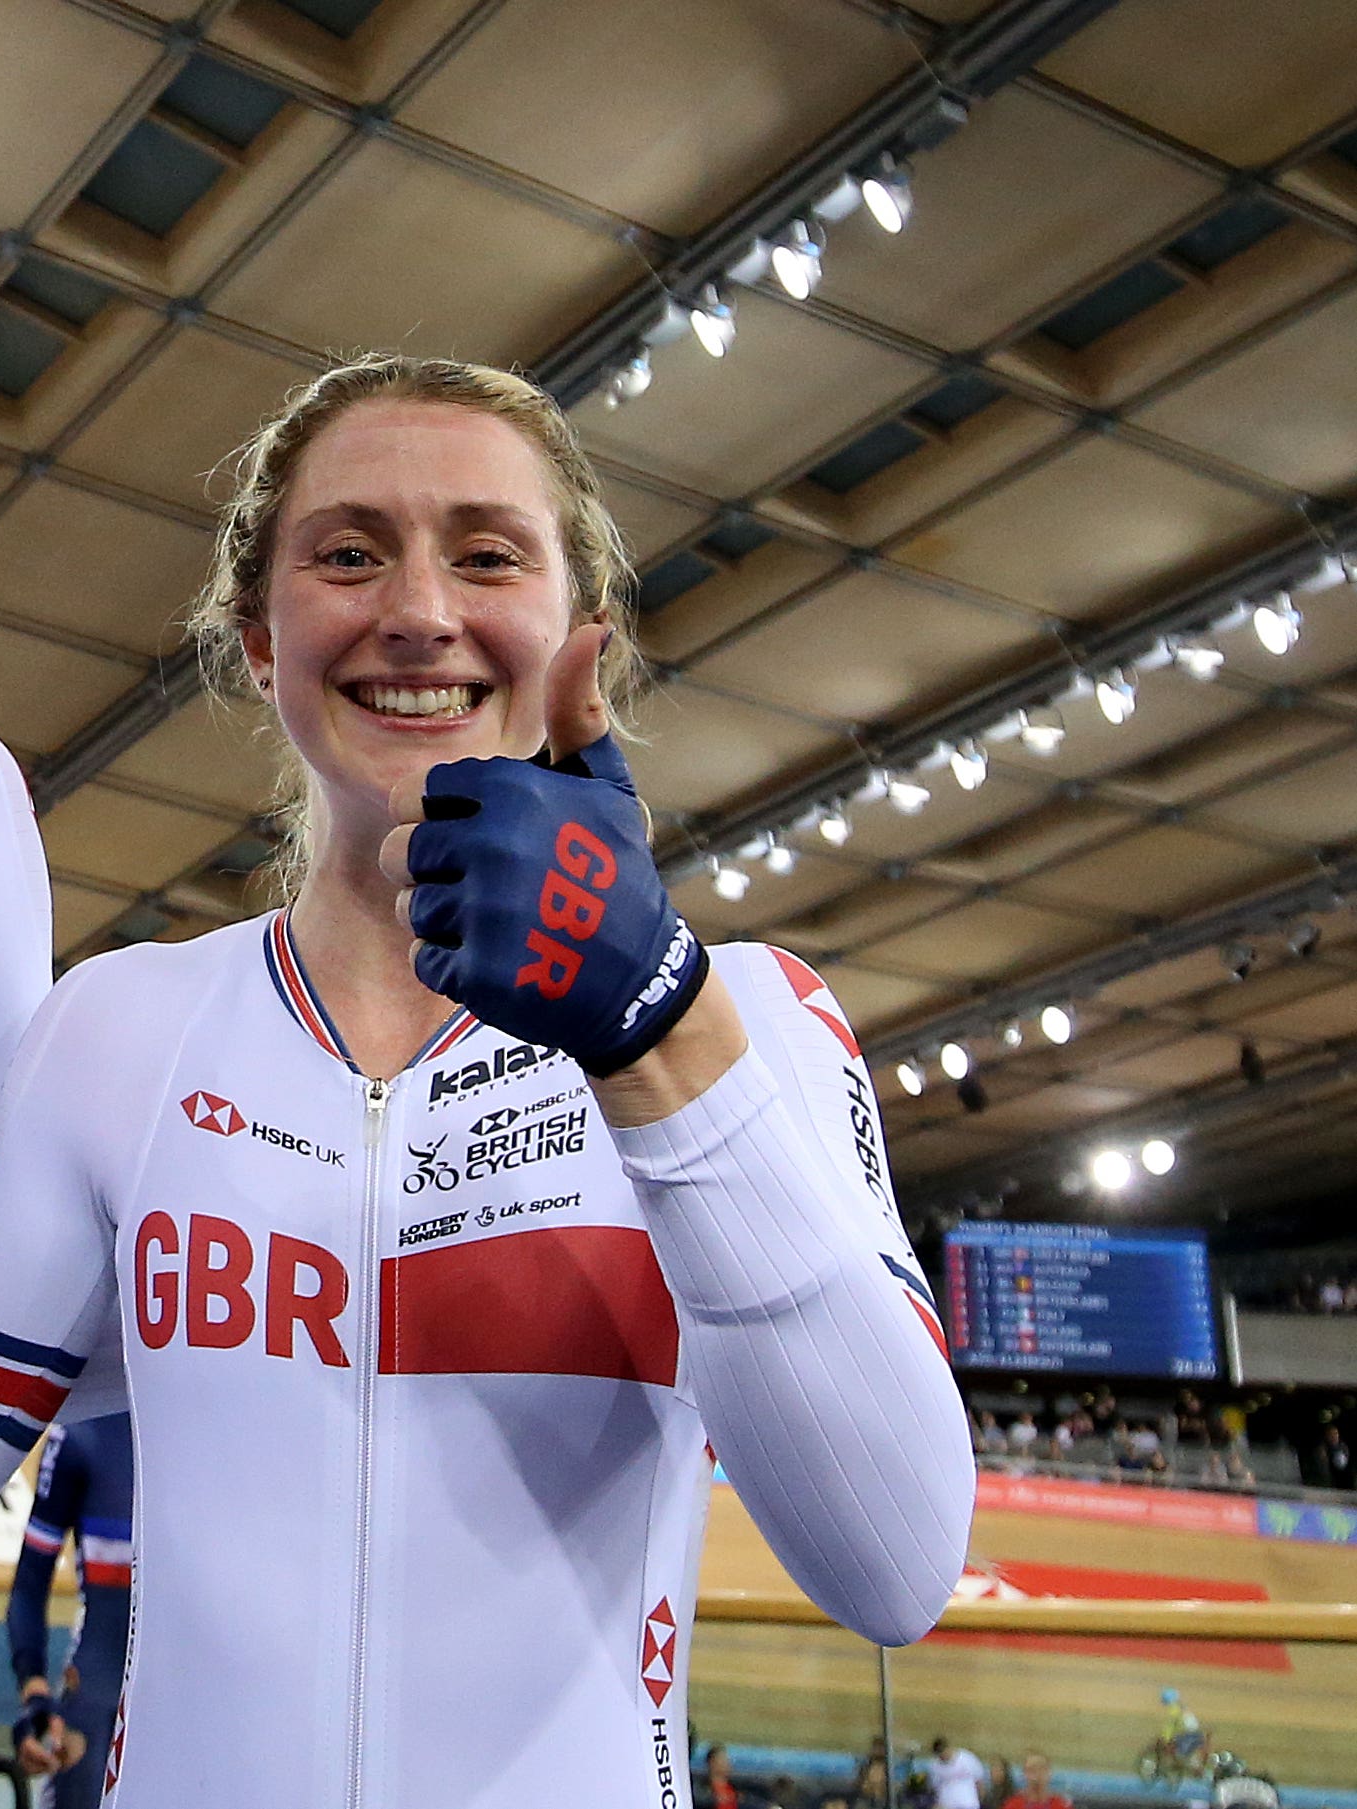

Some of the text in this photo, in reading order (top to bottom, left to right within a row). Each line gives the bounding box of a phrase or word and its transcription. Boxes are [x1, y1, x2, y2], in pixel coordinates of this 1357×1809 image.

[515, 821, 618, 1000] GBR
[622, 916, 695, 1030] kalas
[524, 1085, 589, 1116] HSBC UK
[251, 1121, 346, 1169] HSBC UK
[466, 1107, 587, 1164] BRITISH
[466, 1131, 585, 1182] CYCLING
[843, 1065, 893, 1212] HSBC
[399, 1209, 469, 1237] LOTTERY
[500, 1192, 582, 1218] uk sport
[398, 1223, 462, 1248] FUNDED
[135, 1210, 352, 1369] GBR
[651, 1718, 677, 1809] HSBC
